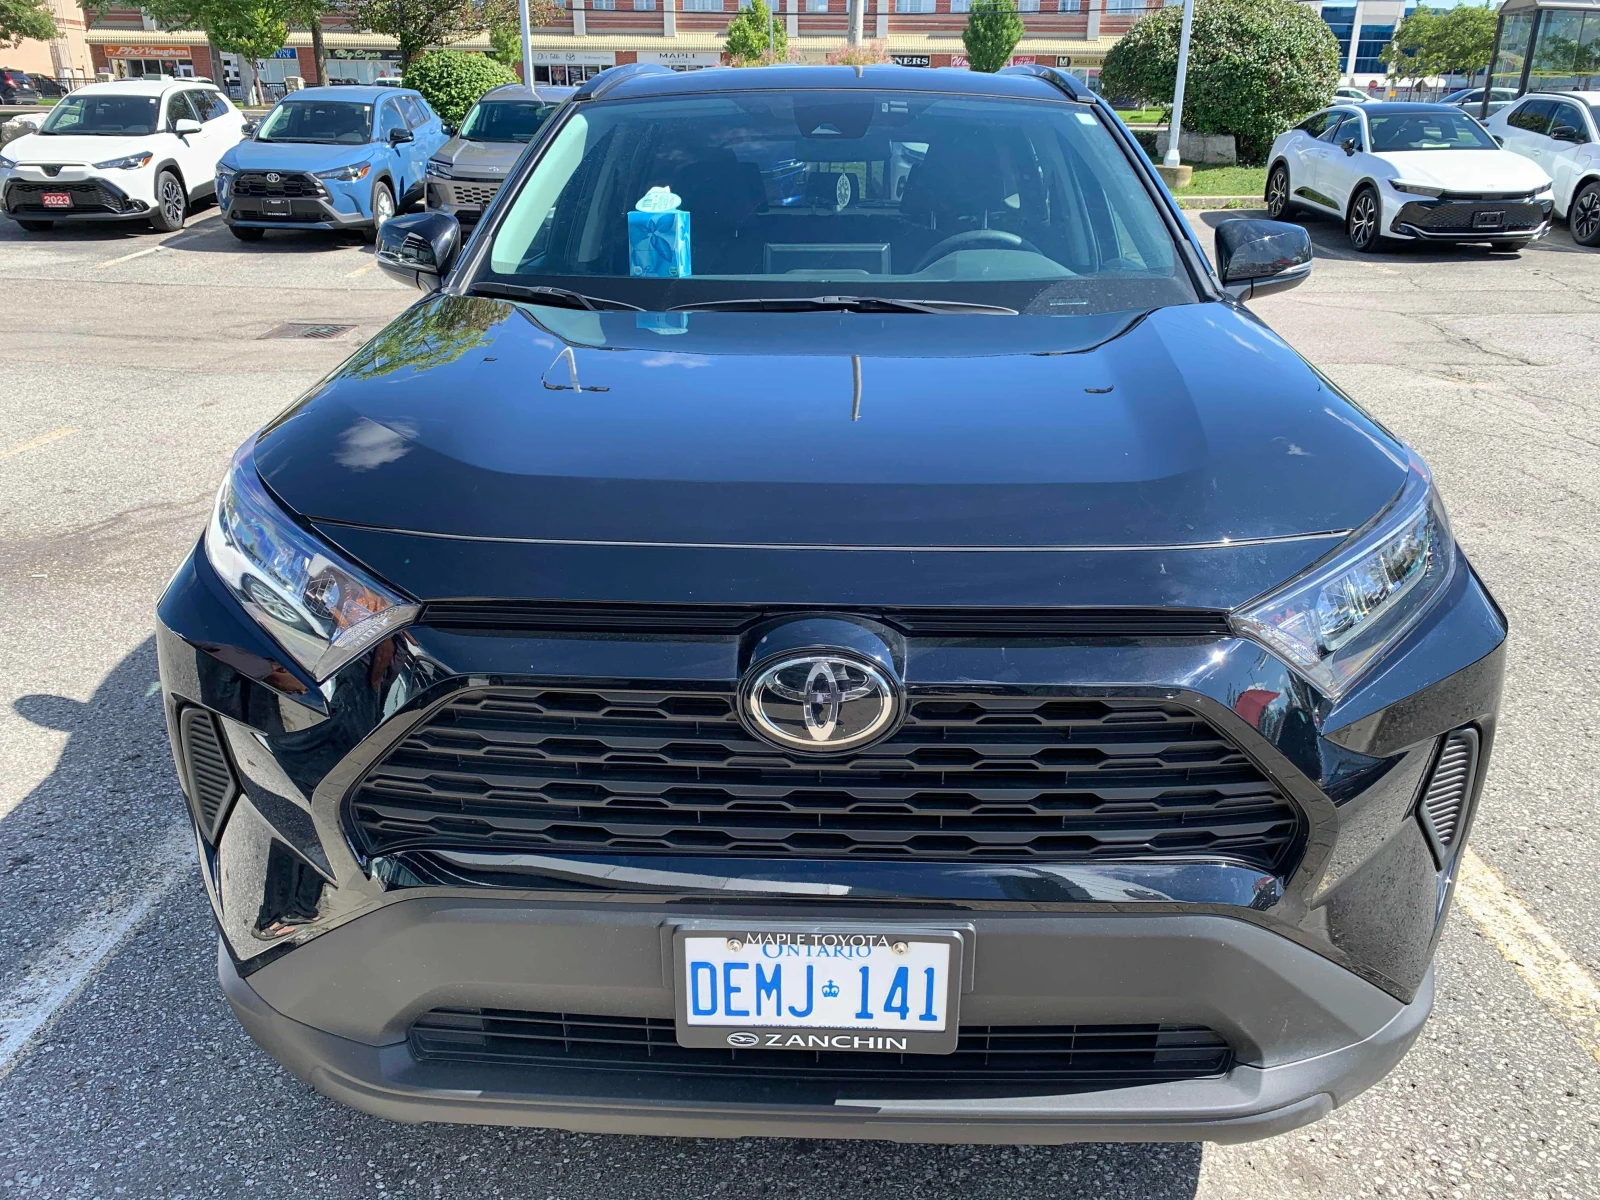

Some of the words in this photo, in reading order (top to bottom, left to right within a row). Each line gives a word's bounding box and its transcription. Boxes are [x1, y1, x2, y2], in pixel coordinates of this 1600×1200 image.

[145, 47, 188, 57] Vaughan
[335, 49, 354, 60] Big
[355, 49, 382, 60] Cigar
[893, 57, 929, 65] NERS
[44, 196, 70, 205] 2023
[745, 932, 805, 946] MAPLE
[811, 934, 890, 948] TOYOTA
[762, 944, 872, 961] ONTARIO
[690, 961, 814, 1018] DEMJ
[855, 965, 938, 1021] 141
[765, 1033, 907, 1050] ZANCHIN
